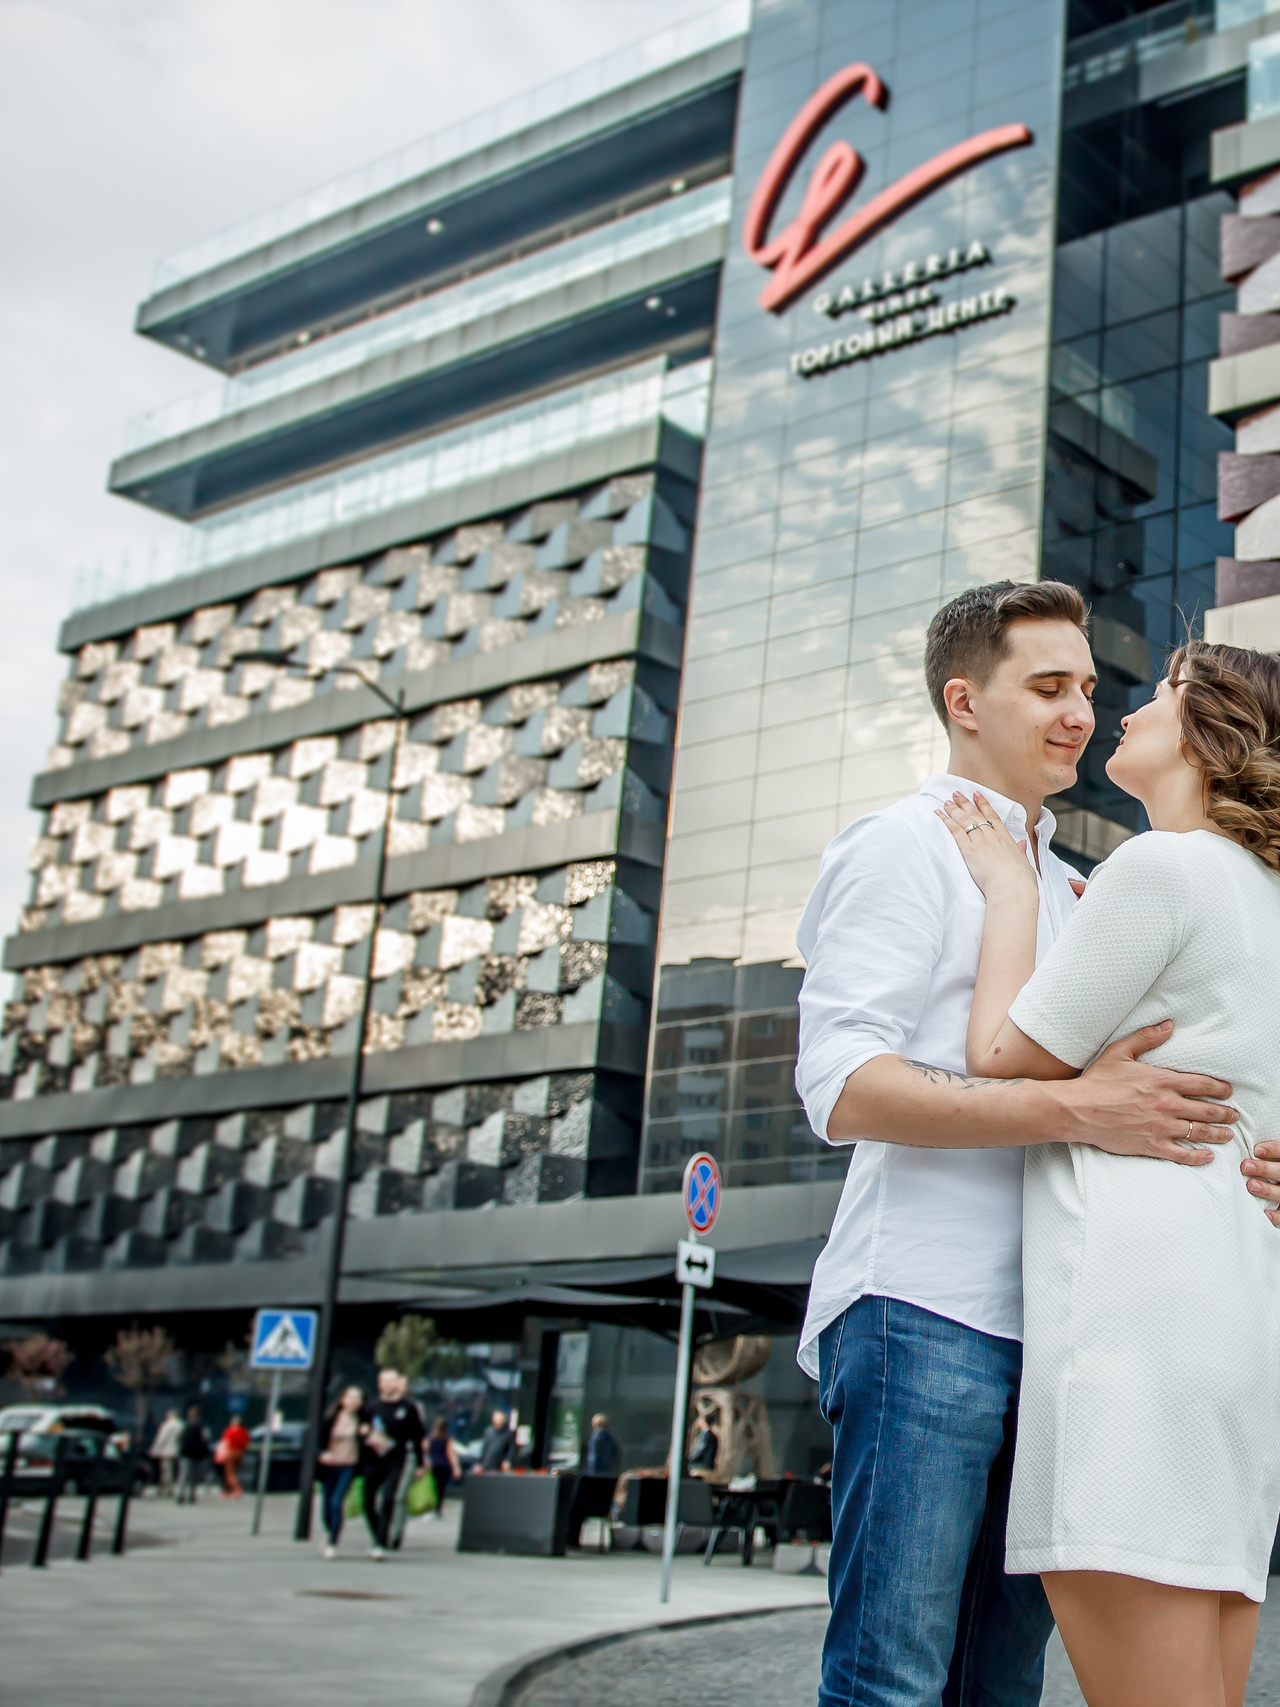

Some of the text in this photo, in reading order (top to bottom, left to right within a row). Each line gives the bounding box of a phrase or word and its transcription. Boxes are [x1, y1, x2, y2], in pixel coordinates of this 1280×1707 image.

[813, 238, 987, 314] GALLERIA
[790, 286, 1009, 374] ТОРГОВЫЙ ЦЕНТР
